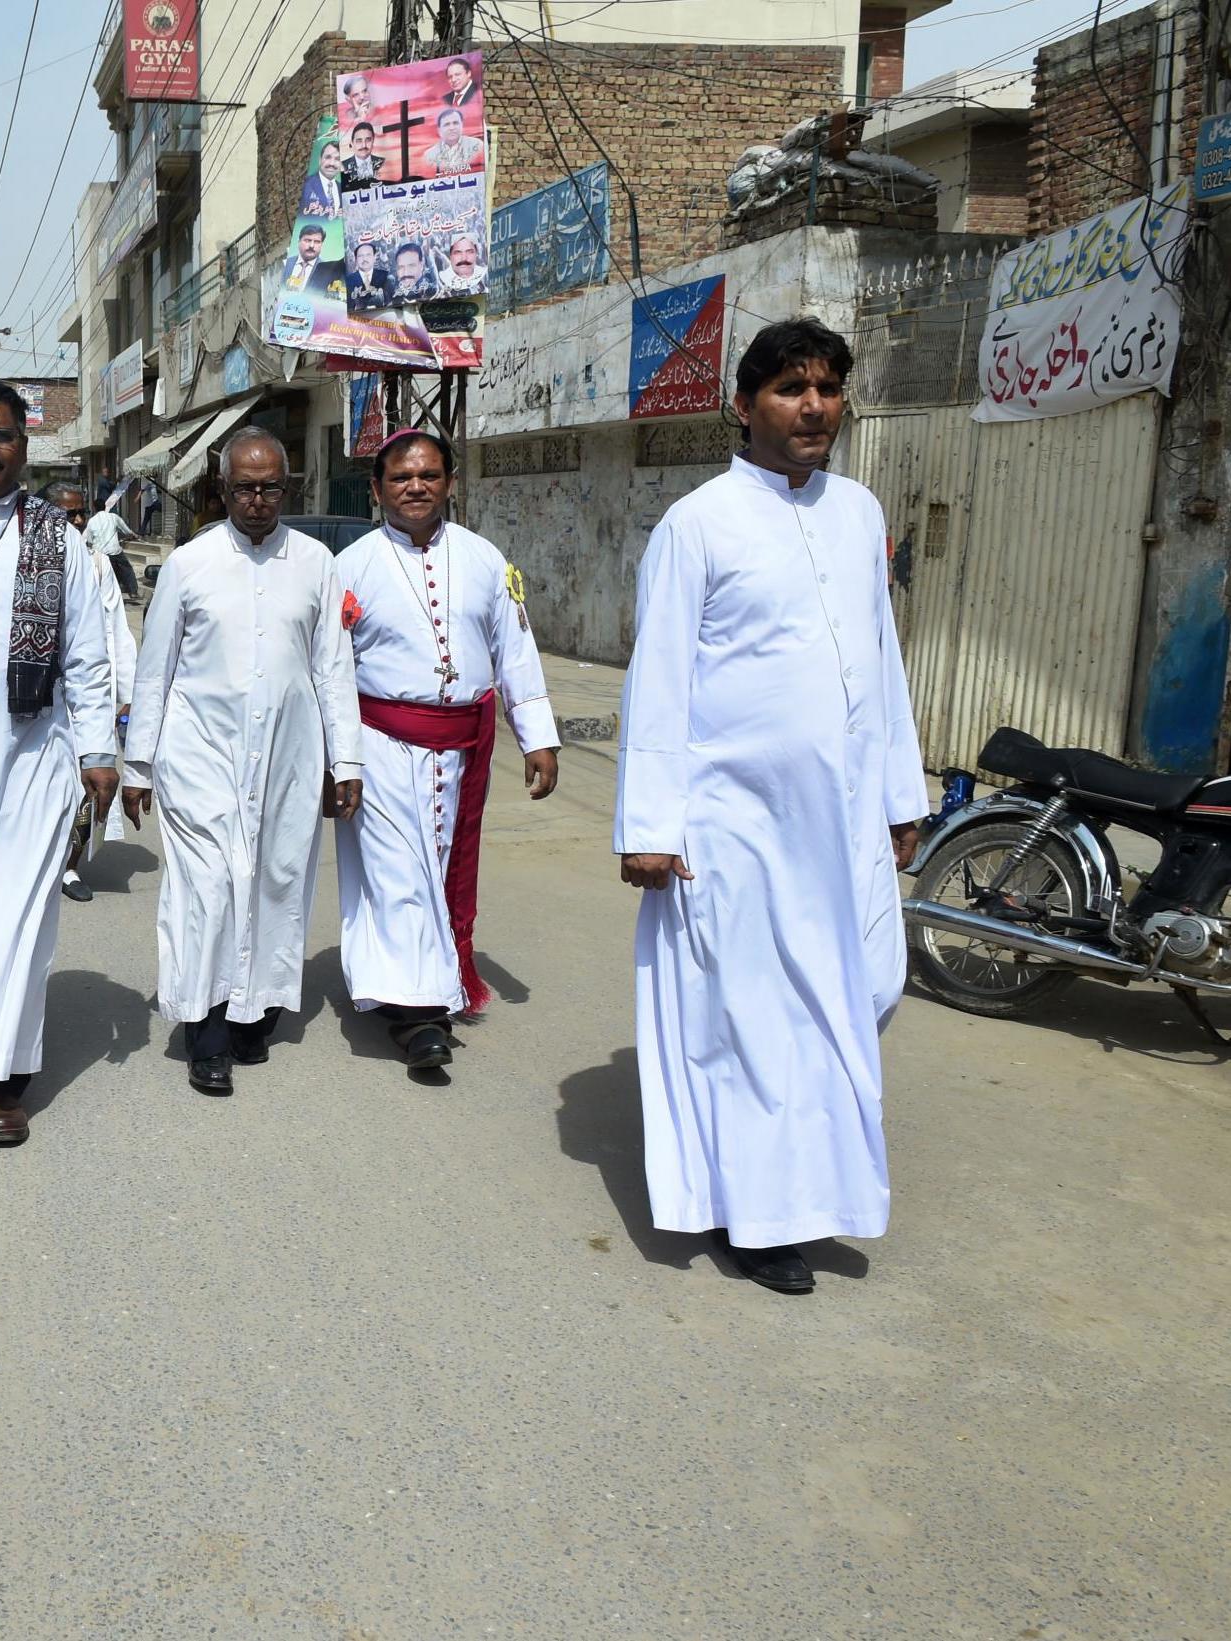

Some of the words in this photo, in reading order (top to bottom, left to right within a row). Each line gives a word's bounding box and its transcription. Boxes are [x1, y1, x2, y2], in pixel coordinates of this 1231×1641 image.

[130, 39, 194, 53] PARAS
[139, 52, 182, 66] GYM
[381, 183, 426, 199] یوحنا
[428, 175, 477, 192] سانحہ
[349, 184, 379, 206] آباد
[490, 213, 519, 245] GUL
[329, 323, 387, 341] Redemptive
[388, 333, 421, 346] History
[707, 312, 721, 344] سکول
[1036, 304, 1089, 393] داخلہ
[987, 340, 1038, 408] جاری
